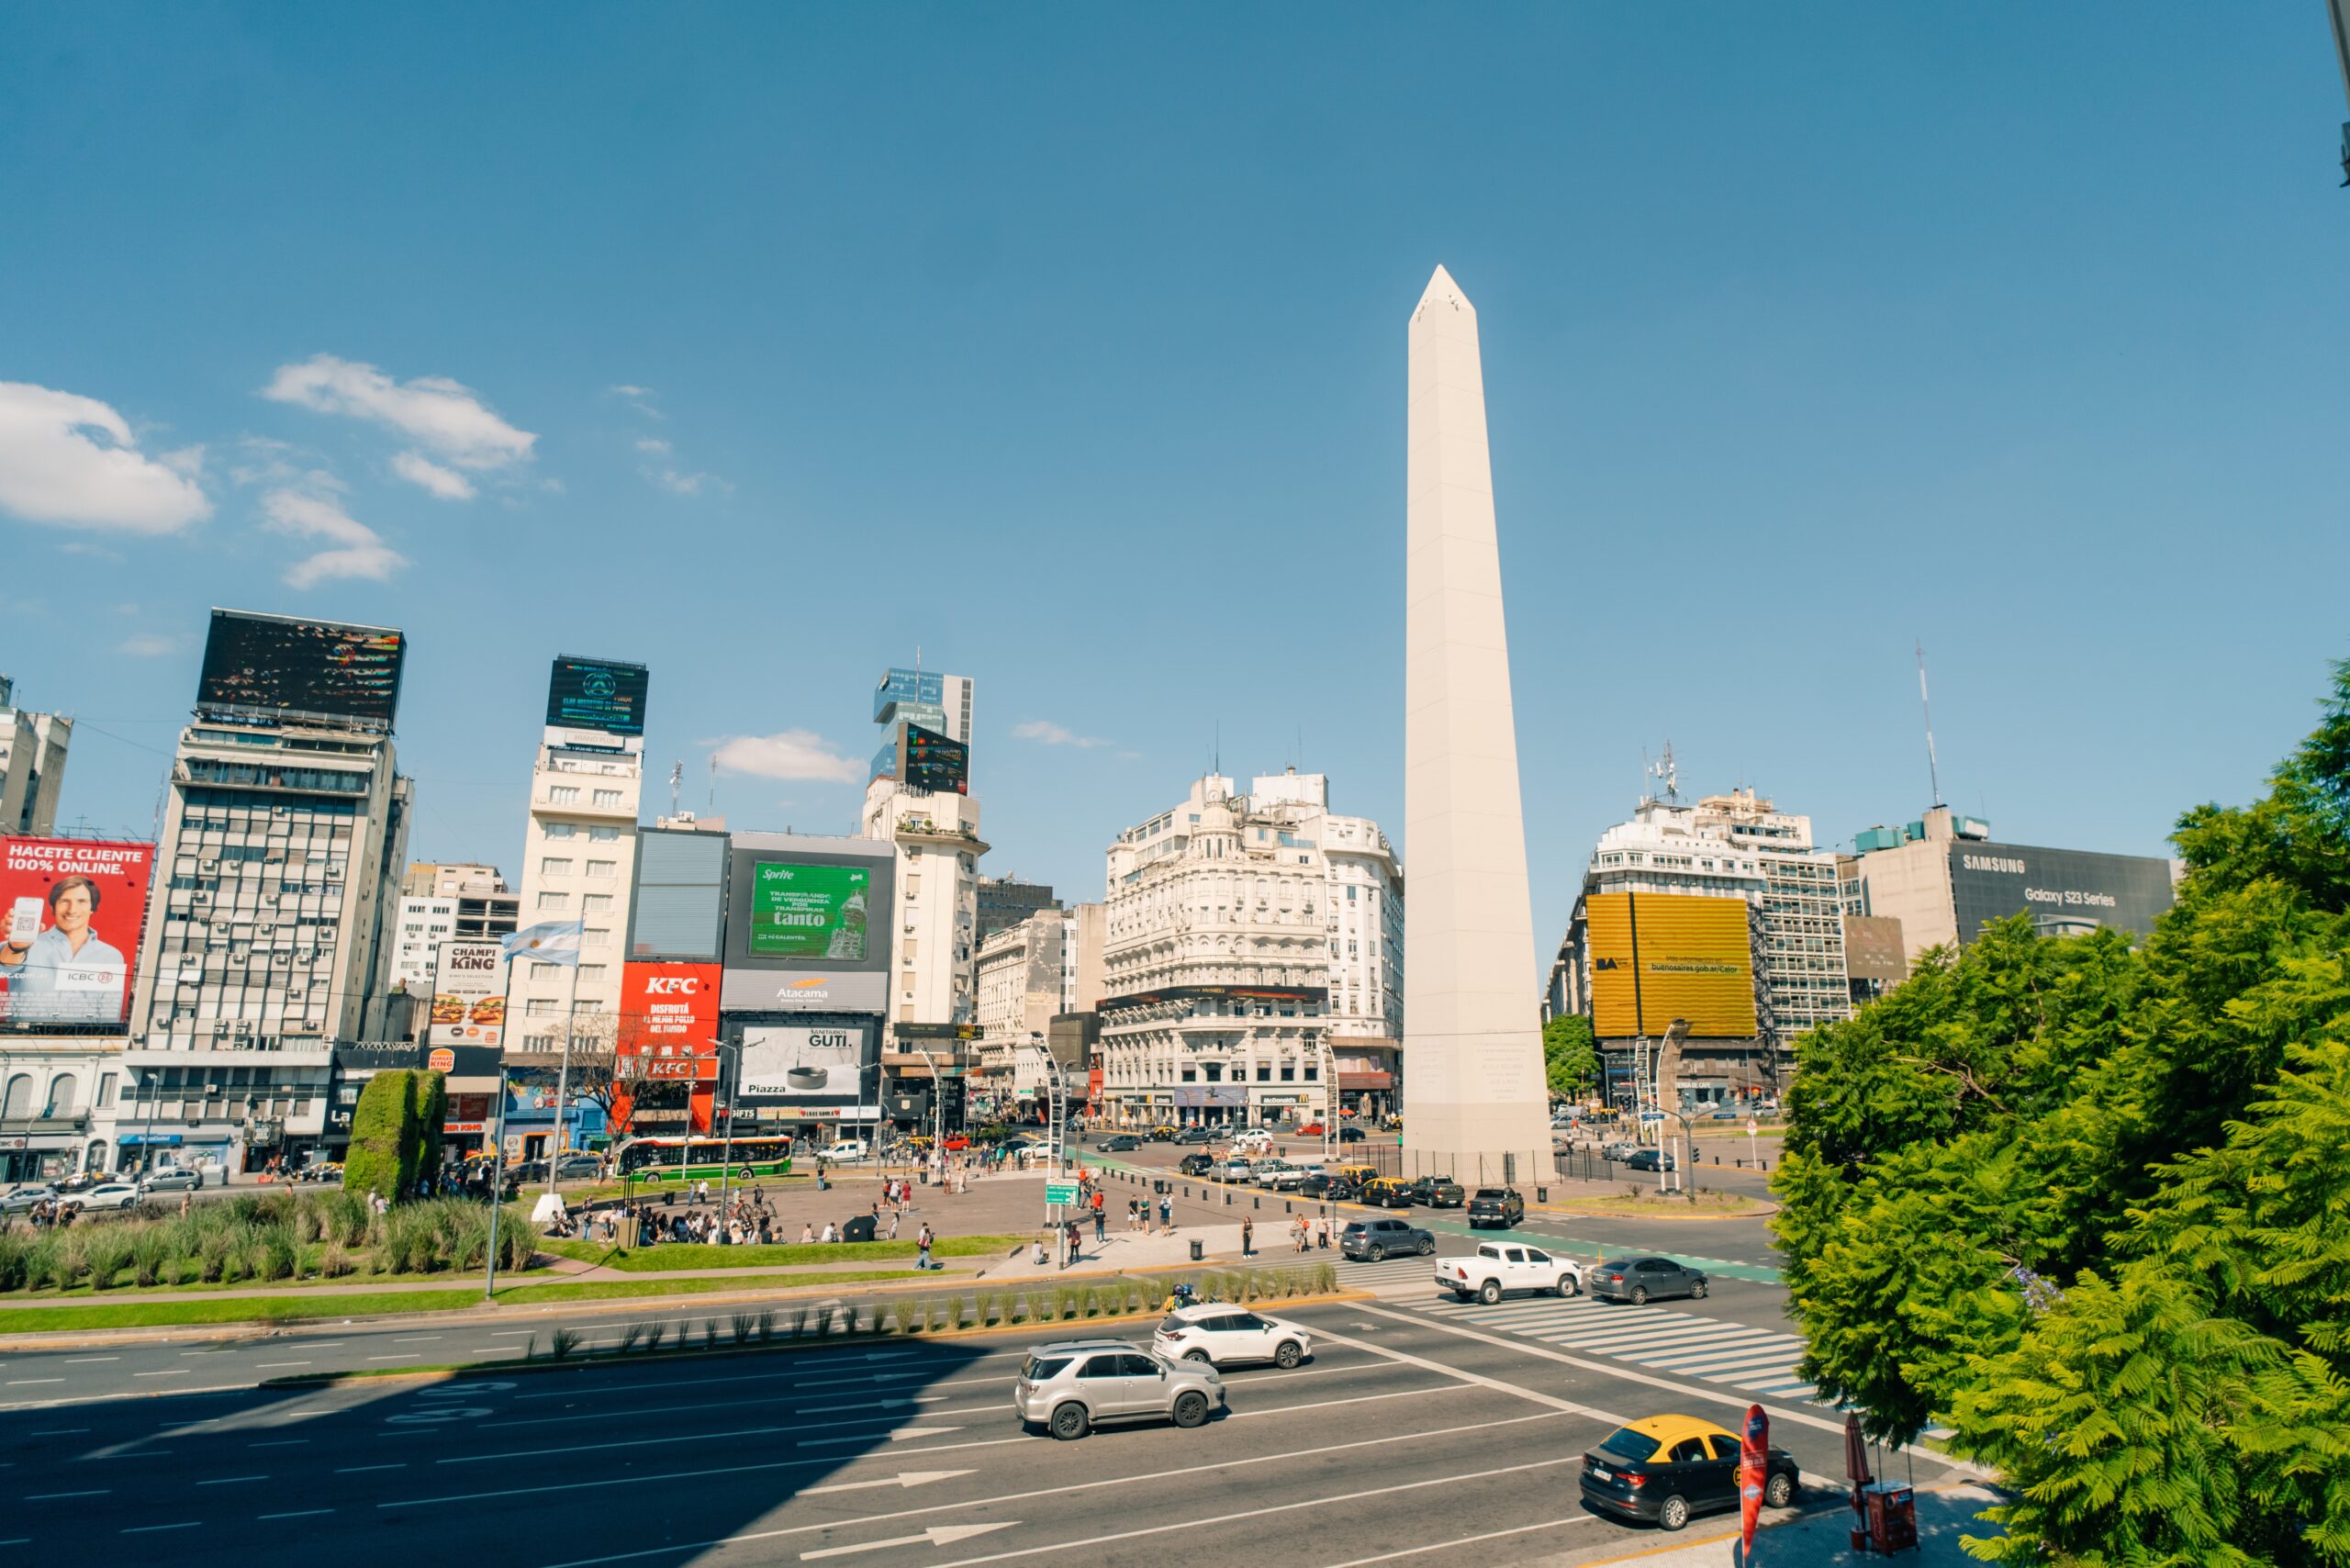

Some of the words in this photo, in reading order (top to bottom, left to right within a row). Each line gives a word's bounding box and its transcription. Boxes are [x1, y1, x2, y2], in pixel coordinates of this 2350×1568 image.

[9, 845, 73, 859] HACETE
[76, 848, 143, 863] CLIENTE
[7, 858, 54, 872] 100%
[58, 861, 125, 875] ONLINE.
[1963, 854, 2026, 874] SAMSUNG
[763, 869, 794, 880] Sprite
[2024, 888, 2063, 906] Galaxy
[2065, 890, 2083, 904] S23
[2084, 892, 2116, 907] Series
[774, 911, 825, 927] tanto
[453, 947, 497, 957] CHAMPI
[1651, 963, 1738, 974] buenosaires.gob.ar/Calor
[67, 973, 95, 981] ICBC
[644, 977, 698, 994] KFC
[777, 988, 828, 999] Atacama
[650, 1002, 689, 1014] DISFRUTÁ
[652, 1014, 674, 1024] MEJOR
[674, 1015, 696, 1024] POLLO
[650, 1025, 663, 1034] DEL
[652, 1062, 688, 1074] KFC
[748, 1084, 786, 1093] Piazza
[330, 1110, 351, 1123] La
